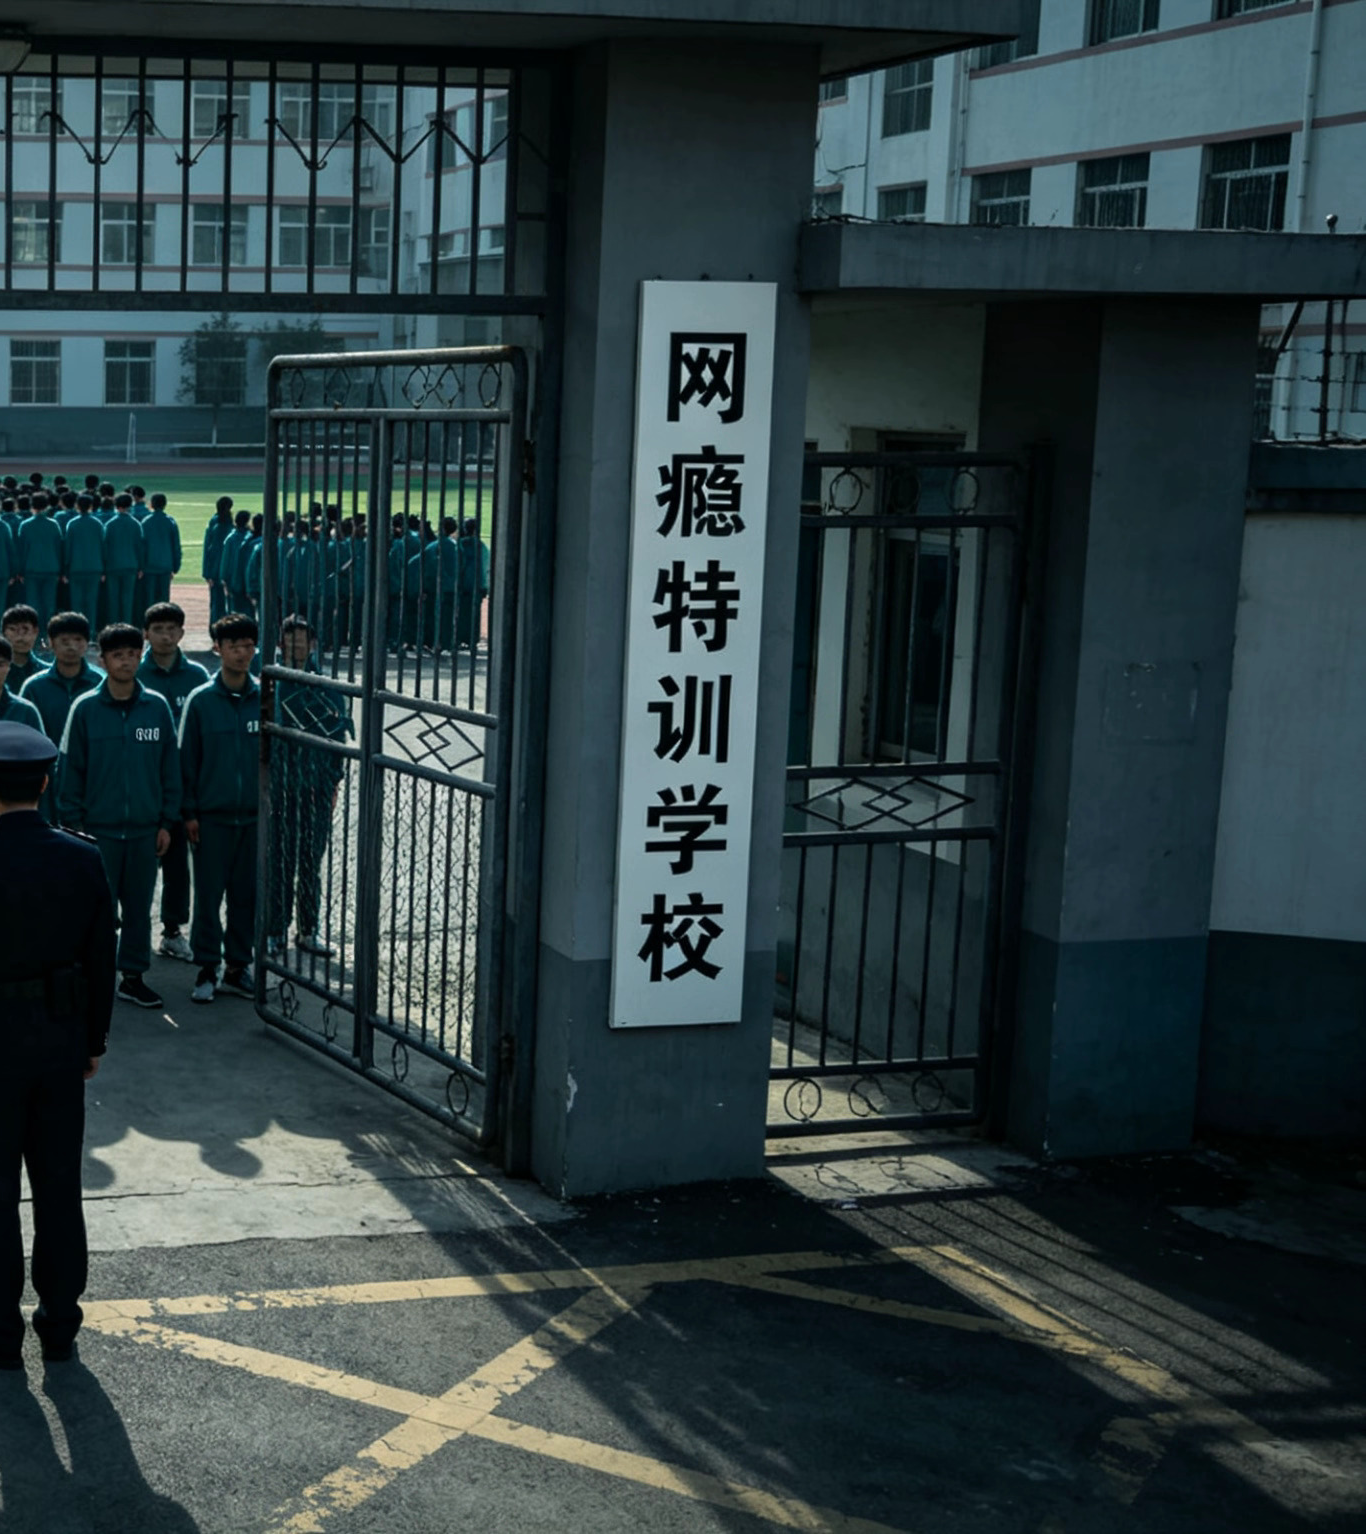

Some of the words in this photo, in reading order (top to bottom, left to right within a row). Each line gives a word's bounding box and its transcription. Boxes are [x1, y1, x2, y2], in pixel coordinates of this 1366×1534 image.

[638, 332, 747, 982] 网瘾特训学校
